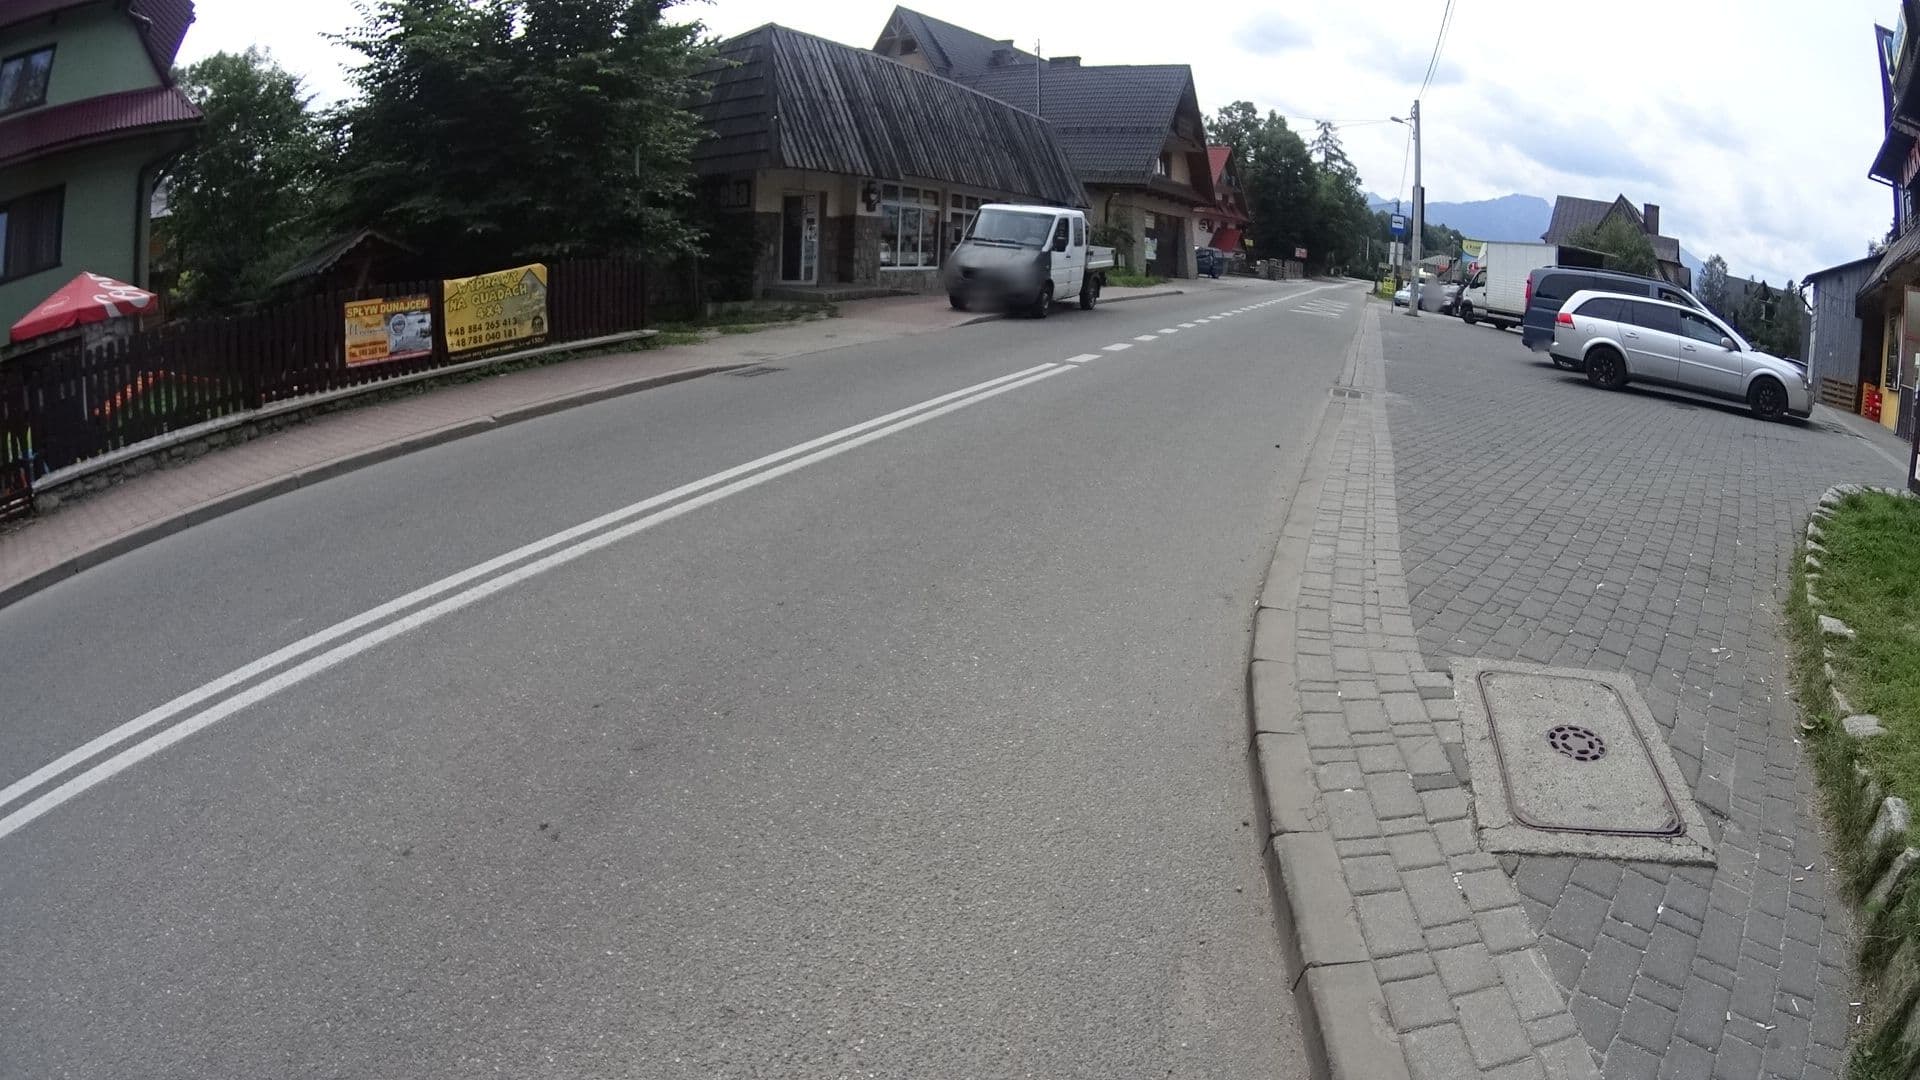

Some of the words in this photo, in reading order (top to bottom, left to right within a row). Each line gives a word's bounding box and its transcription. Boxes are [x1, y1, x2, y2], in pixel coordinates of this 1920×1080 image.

[457, 270, 518, 293] WYPRAWY
[448, 298, 467, 312] NA
[471, 284, 527, 305] QUADACH
[346, 305, 378, 318] SPŁYW
[380, 299, 428, 314] DUNAJCEM
[448, 326, 465, 337] +48
[450, 336, 466, 348] +48
